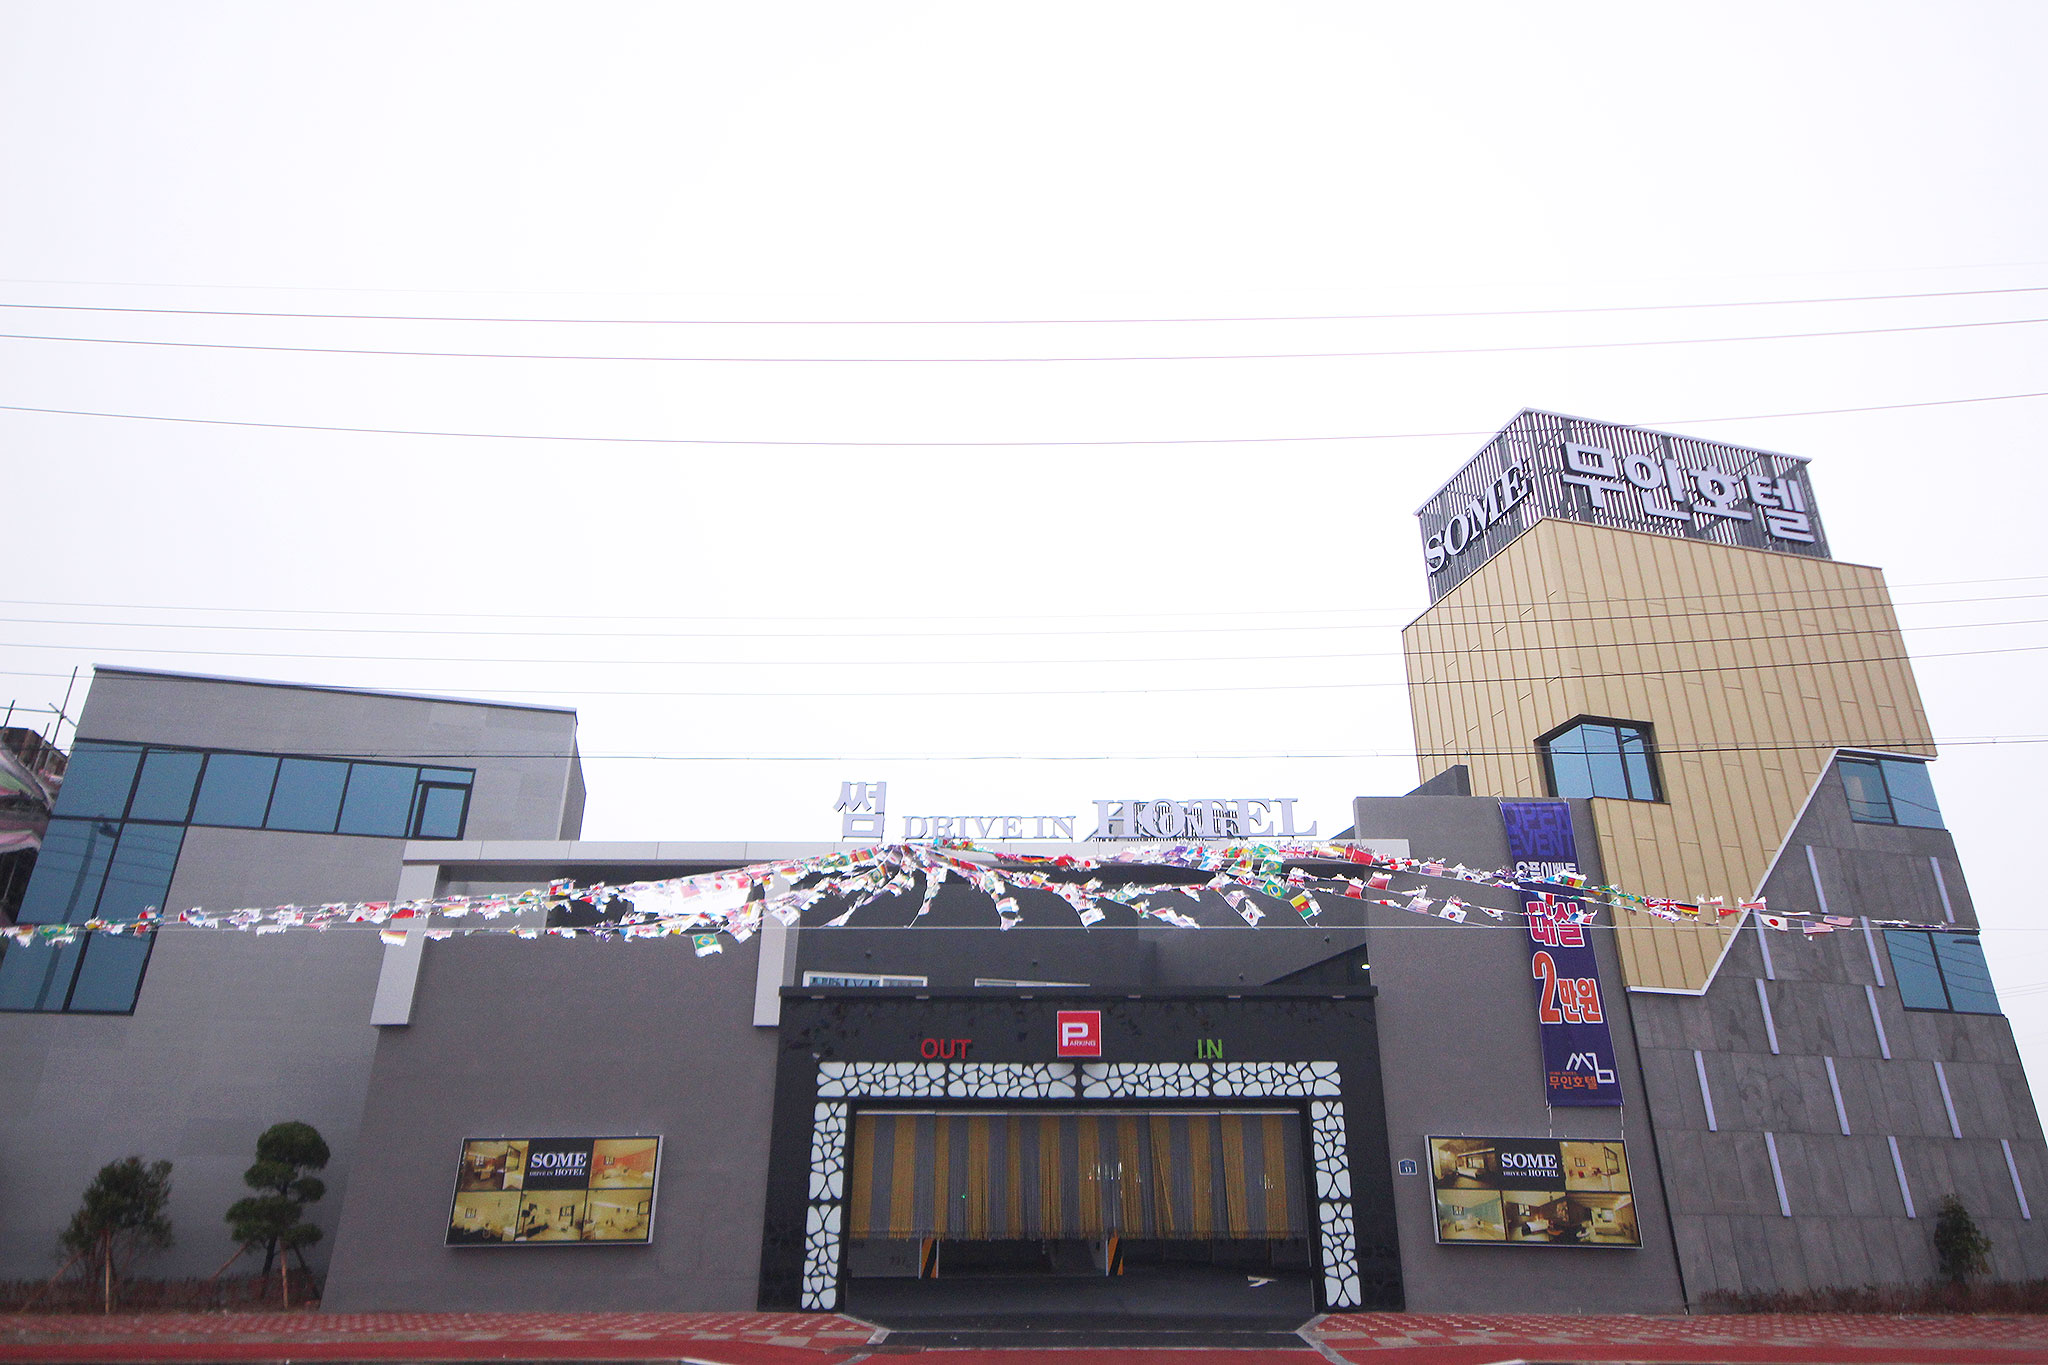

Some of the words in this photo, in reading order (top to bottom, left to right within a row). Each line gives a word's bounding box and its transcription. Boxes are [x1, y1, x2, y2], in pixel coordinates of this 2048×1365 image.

[1563, 441, 1815, 543] 무인호텔
[1426, 458, 1533, 576] SOME
[833, 782, 887, 838] 썸
[902, 815, 1023, 839] DRIVE
[1034, 815, 1076, 839] IN
[1092, 798, 1317, 838] HOTEL
[1502, 804, 1570, 831] OPEN
[1509, 831, 1575, 857] EVENT
[1526, 901, 1585, 947] 대실
[1532, 951, 1604, 1024] 2만원
[1062, 1022, 1096, 1047] PARKING
[920, 1038, 972, 1059] OUT
[1197, 1038, 1223, 1060] IN
[1549, 1075, 1598, 1090] 무인호텔
[530, 1152, 587, 1168] SOME
[554, 1168, 585, 1176] HOTEL
[1501, 1153, 1558, 1169] SOME
[1528, 1169, 1559, 1177] HOTEL
